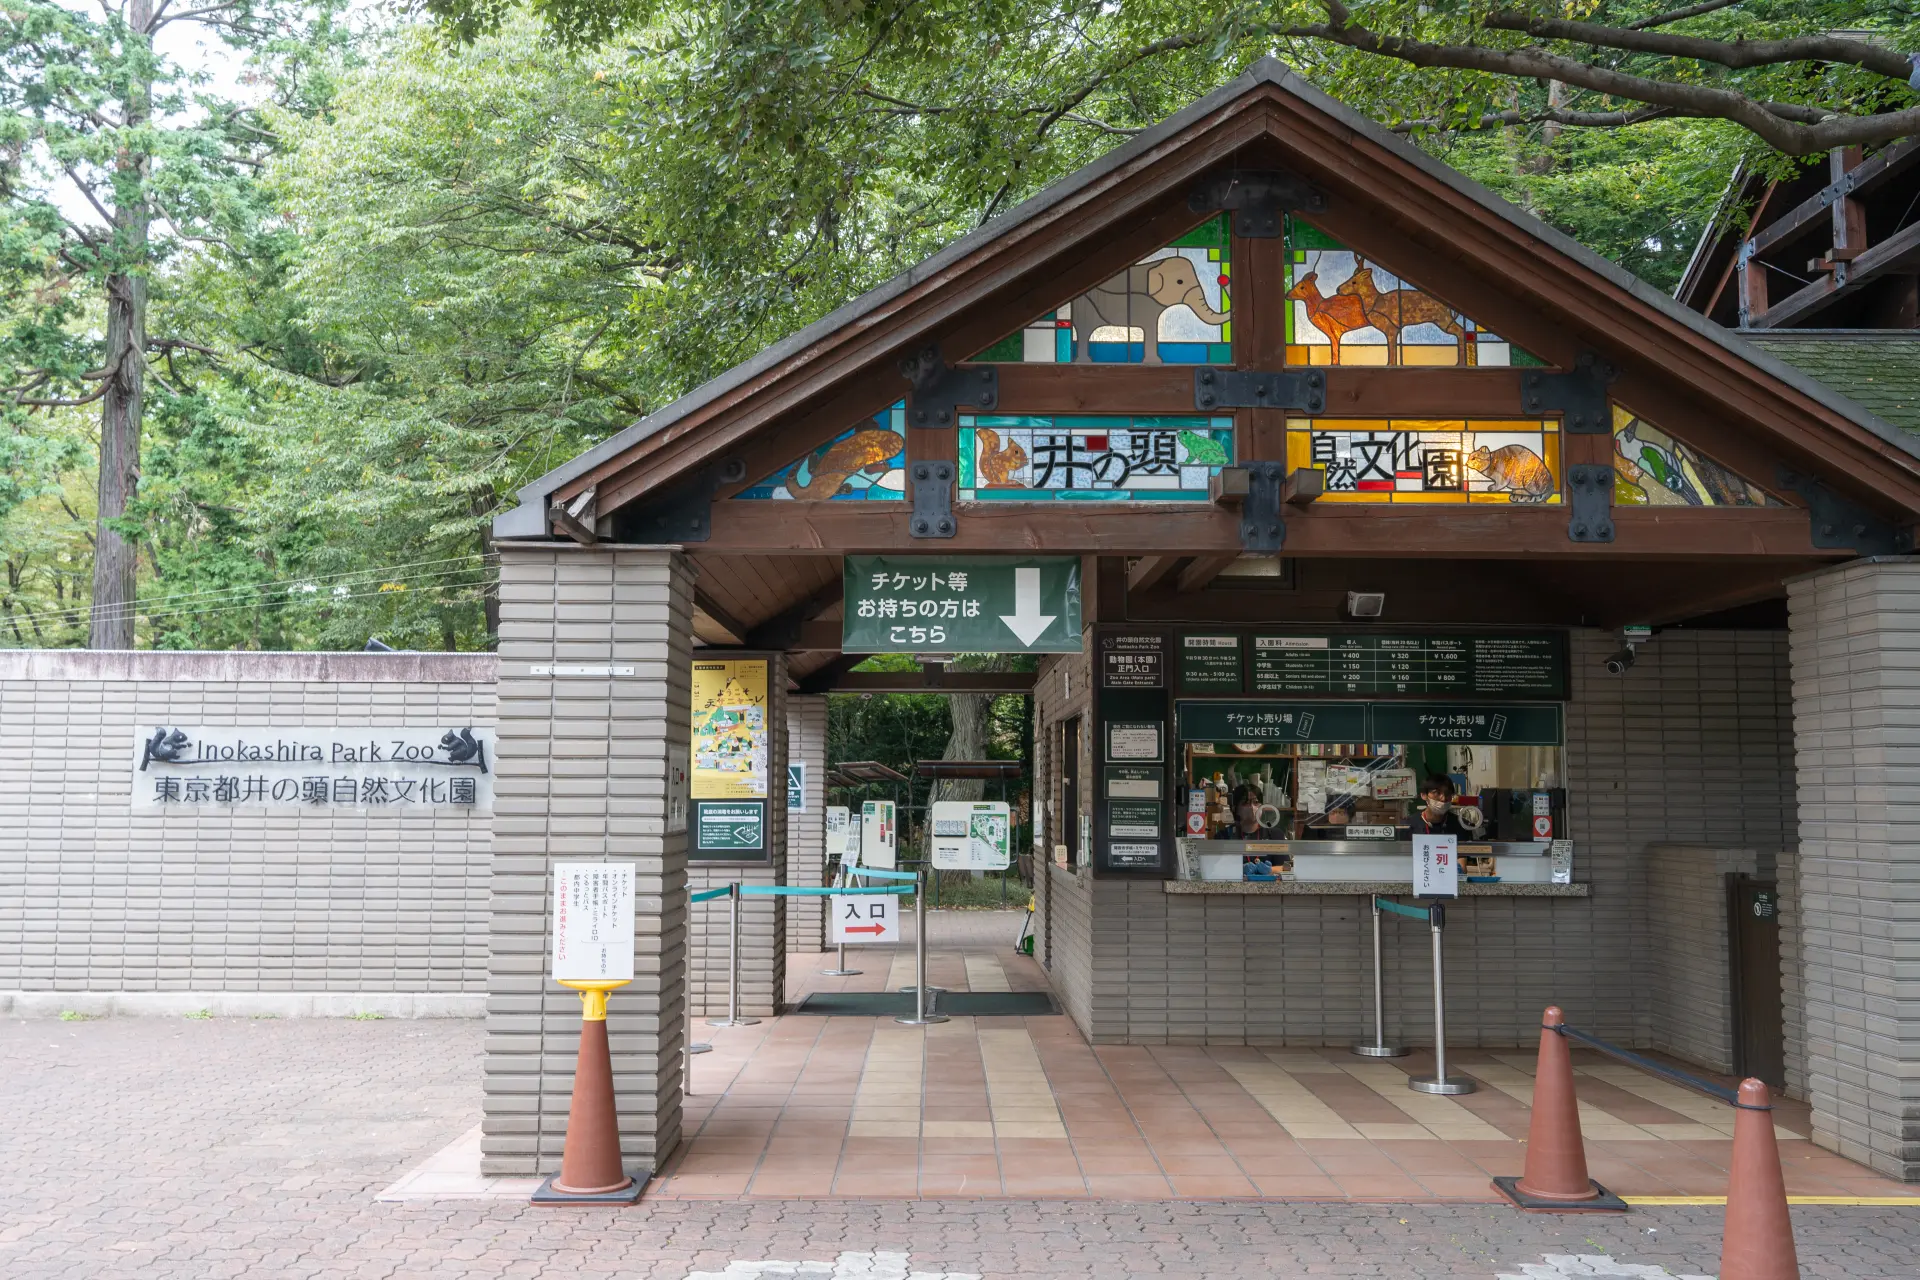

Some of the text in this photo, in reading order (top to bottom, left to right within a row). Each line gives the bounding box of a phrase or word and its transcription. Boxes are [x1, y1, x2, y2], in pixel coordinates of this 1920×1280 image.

[1033, 428, 1179, 488] 井の頭
[1312, 431, 1463, 491] 自然文化園
[871, 572, 968, 592] チケット等
[857, 598, 981, 618] お持ちの方は
[890, 625, 946, 644] こちら
[1226, 713, 1293, 724] チケット売り場
[1418, 714, 1485, 726] チケット売り場
[1236, 727, 1280, 736] TICKETS
[1429, 728, 1473, 738] TICKETS
[198, 740, 434, 762] Inokashira Park Zoo
[152, 775, 476, 804] 東京都井の頭自然文化園
[1436, 846, 1449, 874] 一列に
[845, 903, 885, 920] 入口
